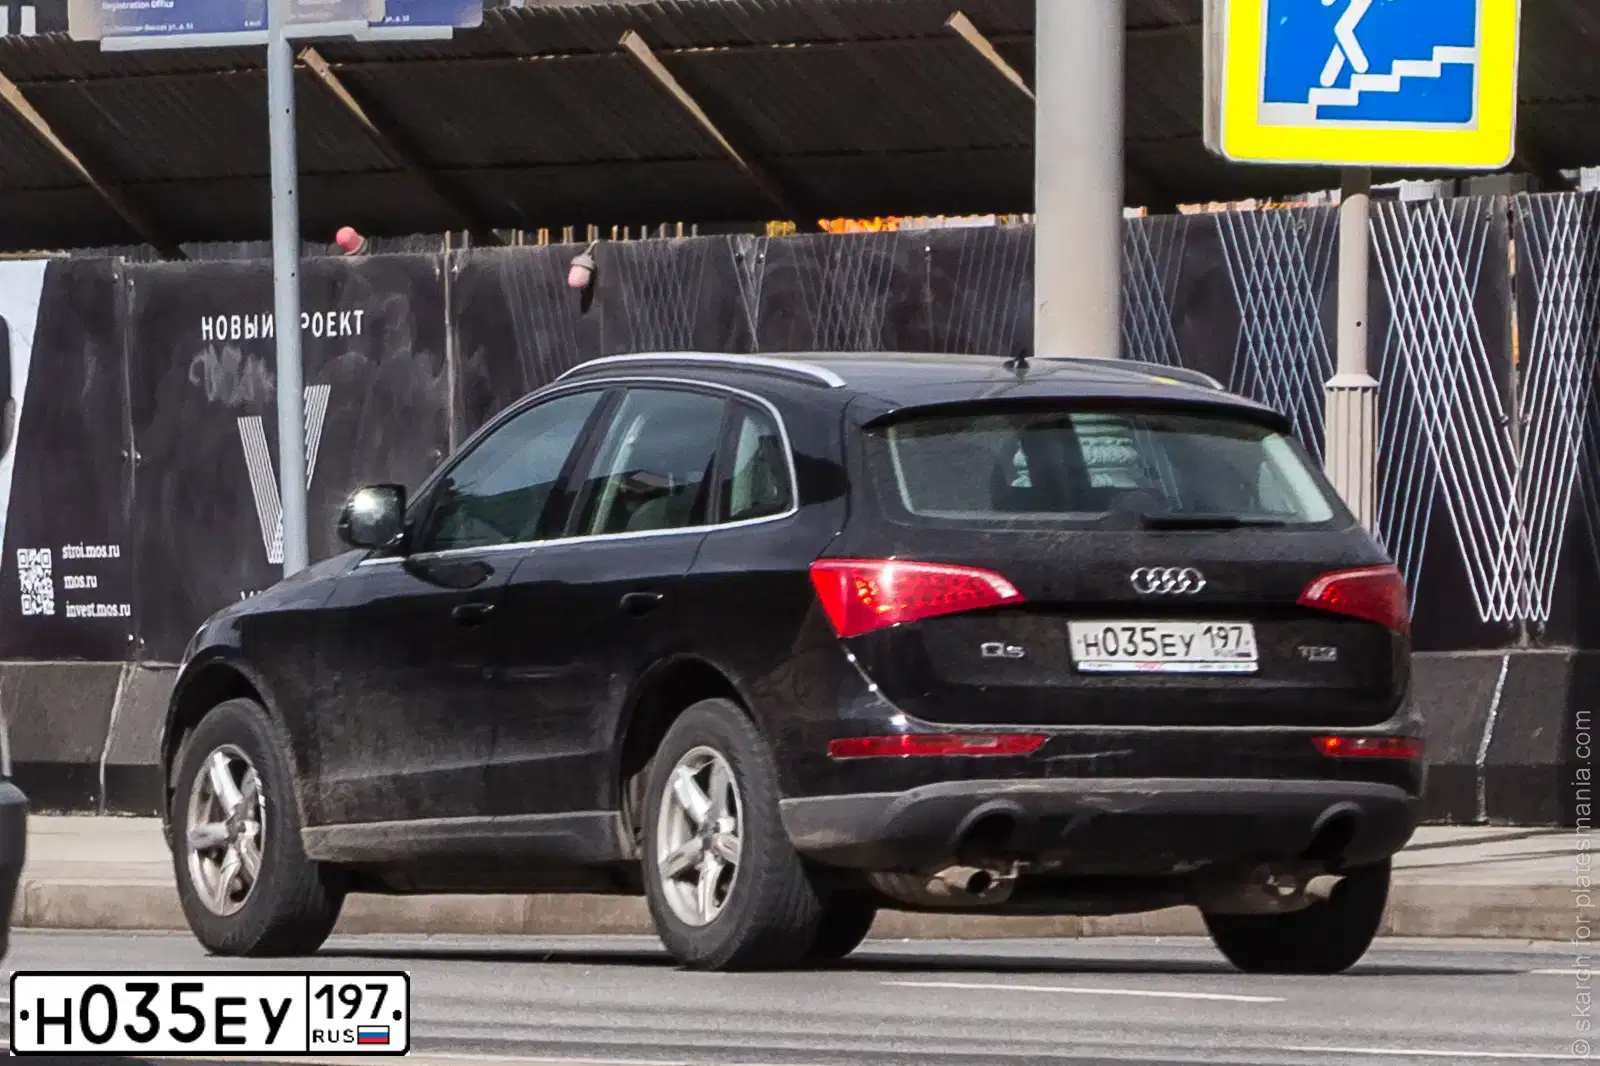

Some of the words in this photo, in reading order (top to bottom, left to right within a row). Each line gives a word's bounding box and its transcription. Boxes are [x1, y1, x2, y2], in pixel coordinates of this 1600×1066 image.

[151, 0, 175, 9] Office
[300, 309, 364, 337] РОЕКТ
[62, 541, 120, 559] stroi.mos.ru
[63, 575, 97, 589] mos.ru
[66, 600, 131, 617] invest.mos.ru
[1203, 625, 1244, 649] 197
